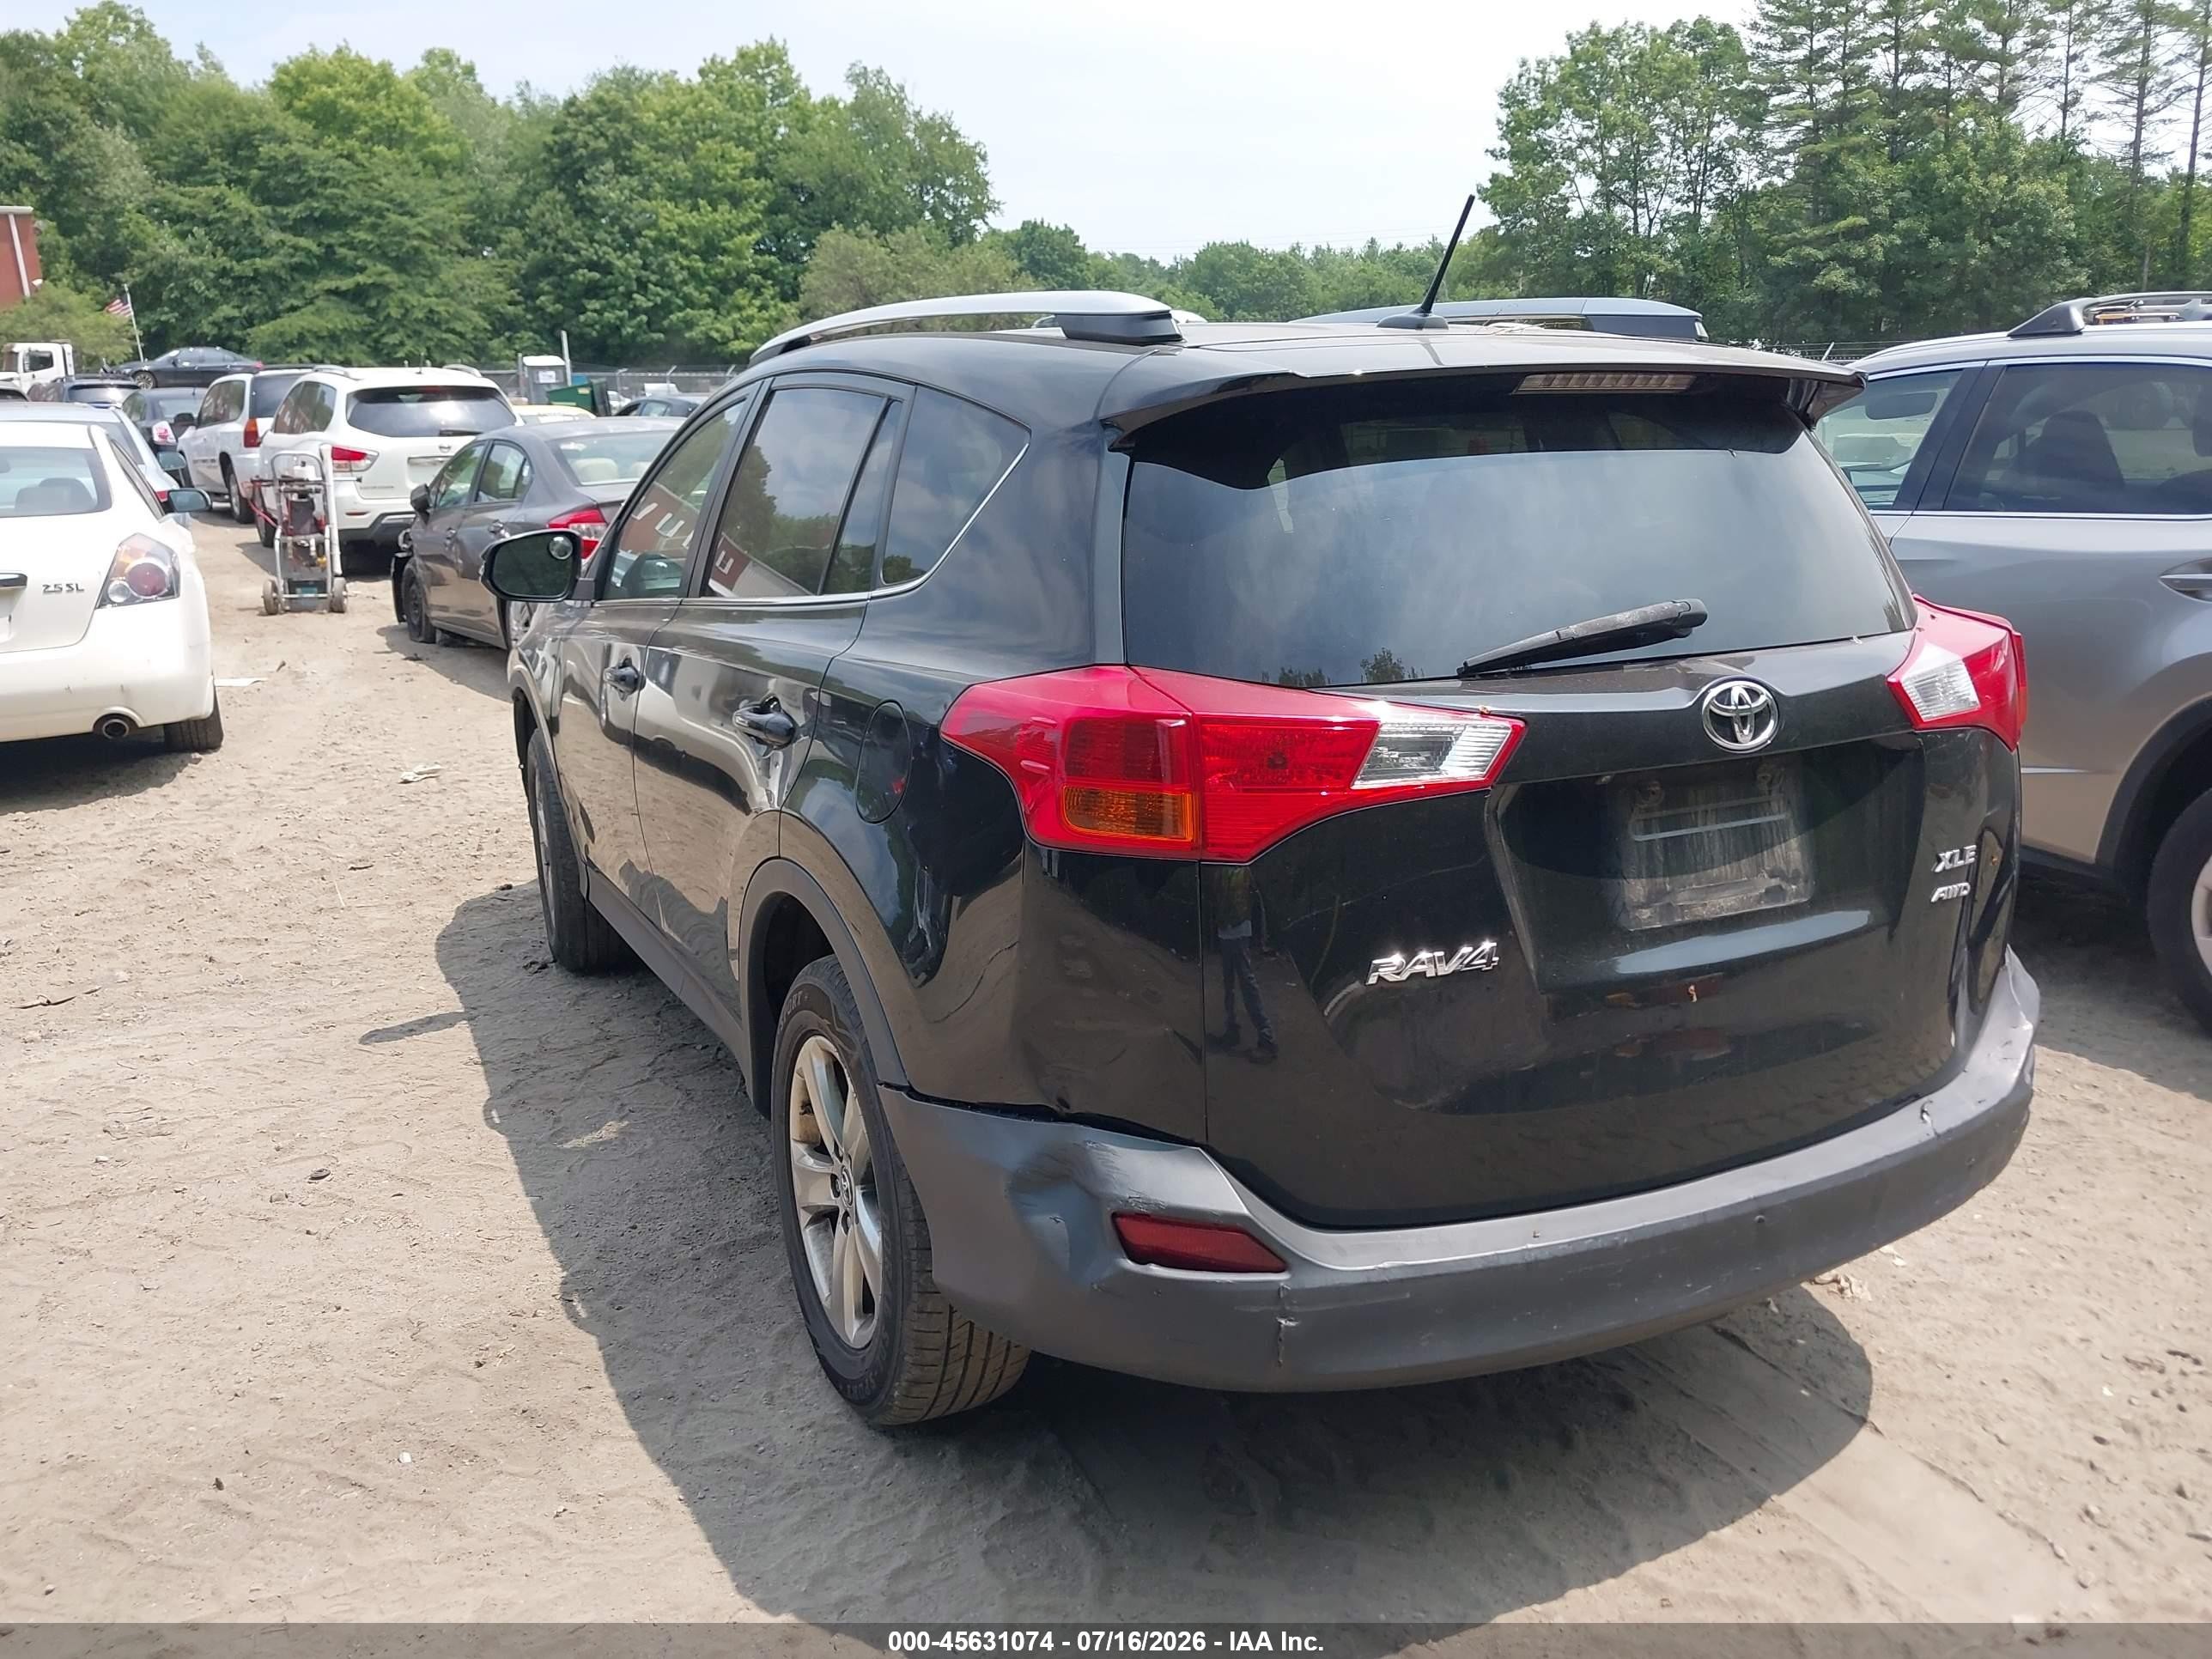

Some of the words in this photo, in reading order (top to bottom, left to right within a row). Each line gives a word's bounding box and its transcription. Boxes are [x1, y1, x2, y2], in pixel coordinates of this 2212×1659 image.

[65, 582, 85, 593] SL
[1930, 844, 1978, 873] XLE
[1929, 882, 1972, 903] AWD
[1364, 940, 1500, 987] RAV4
